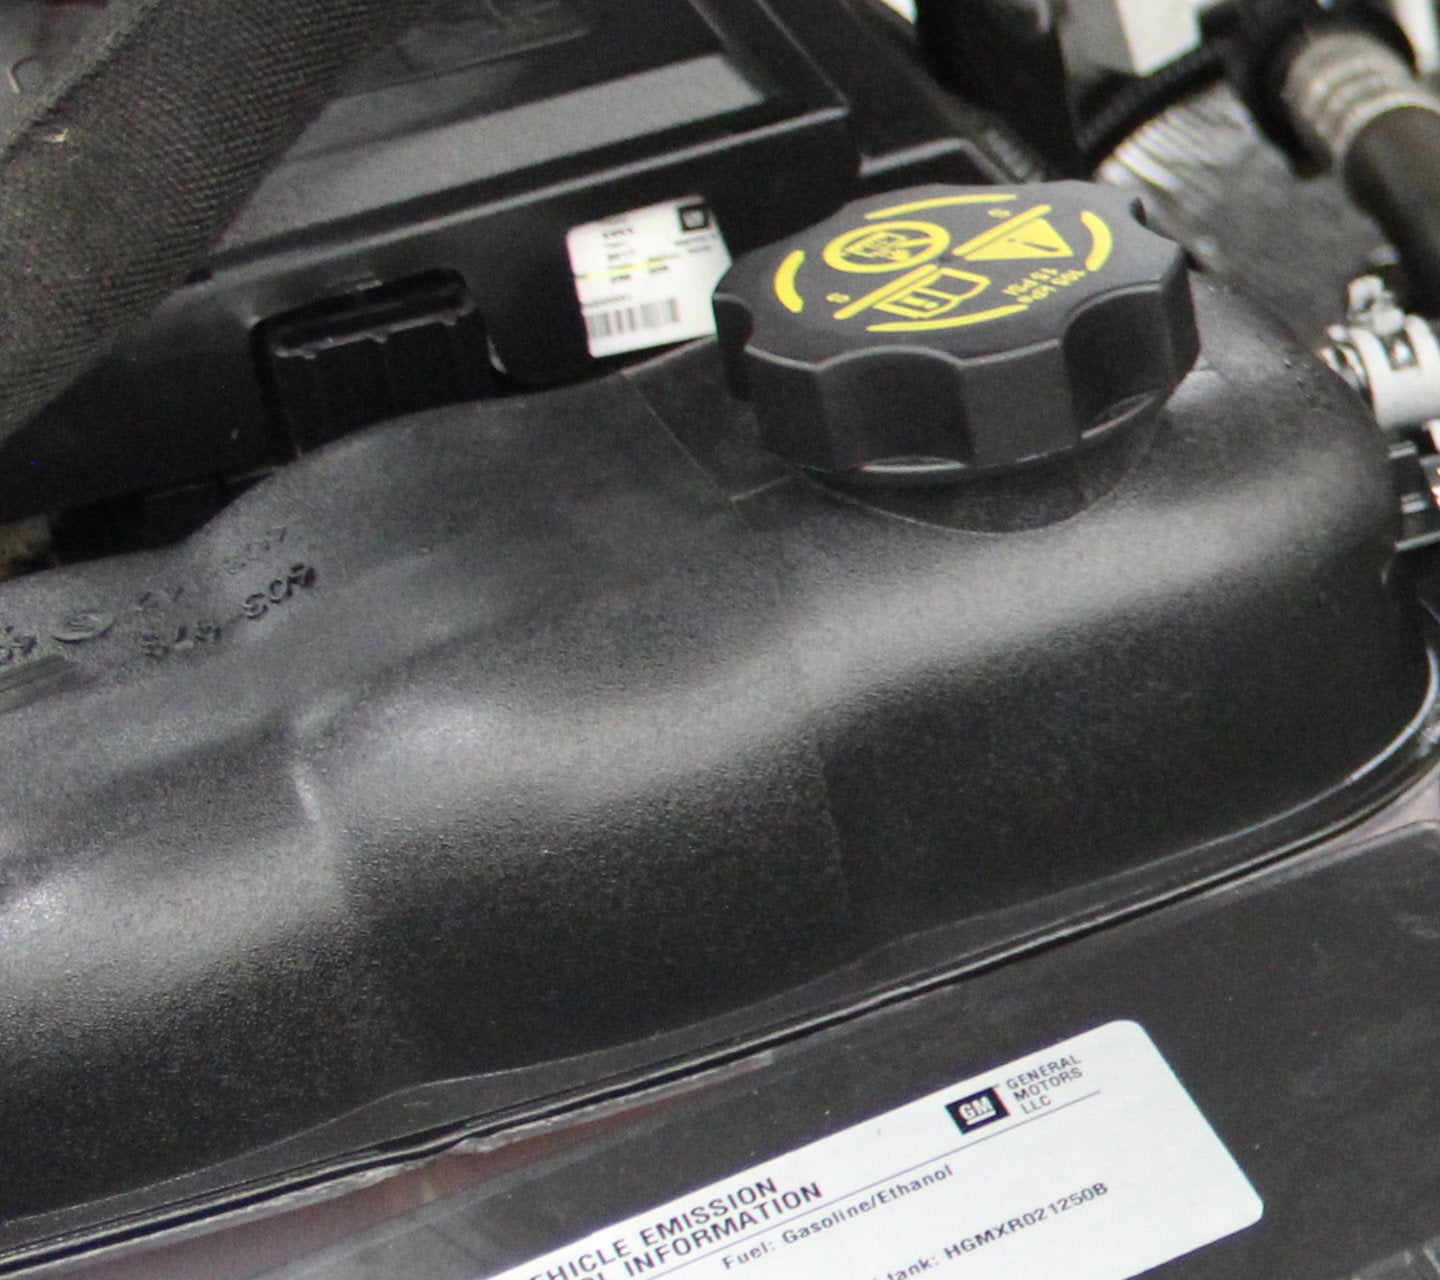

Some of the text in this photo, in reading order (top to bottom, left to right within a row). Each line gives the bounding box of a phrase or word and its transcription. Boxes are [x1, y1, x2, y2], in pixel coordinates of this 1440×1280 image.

[1006, 1055, 1079, 1090] GENERAL
[1012, 1067, 1083, 1102] MOTORS
[959, 1096, 996, 1125] GM
[1020, 1094, 1052, 1115] LLC
[624, 1182, 822, 1276] INFORMATION
[639, 1178, 777, 1247] EMISSION
[721, 1164, 953, 1270] Fuel: Gasoline/Ethanol
[944, 1182, 1108, 1259] HGMXR021250B
